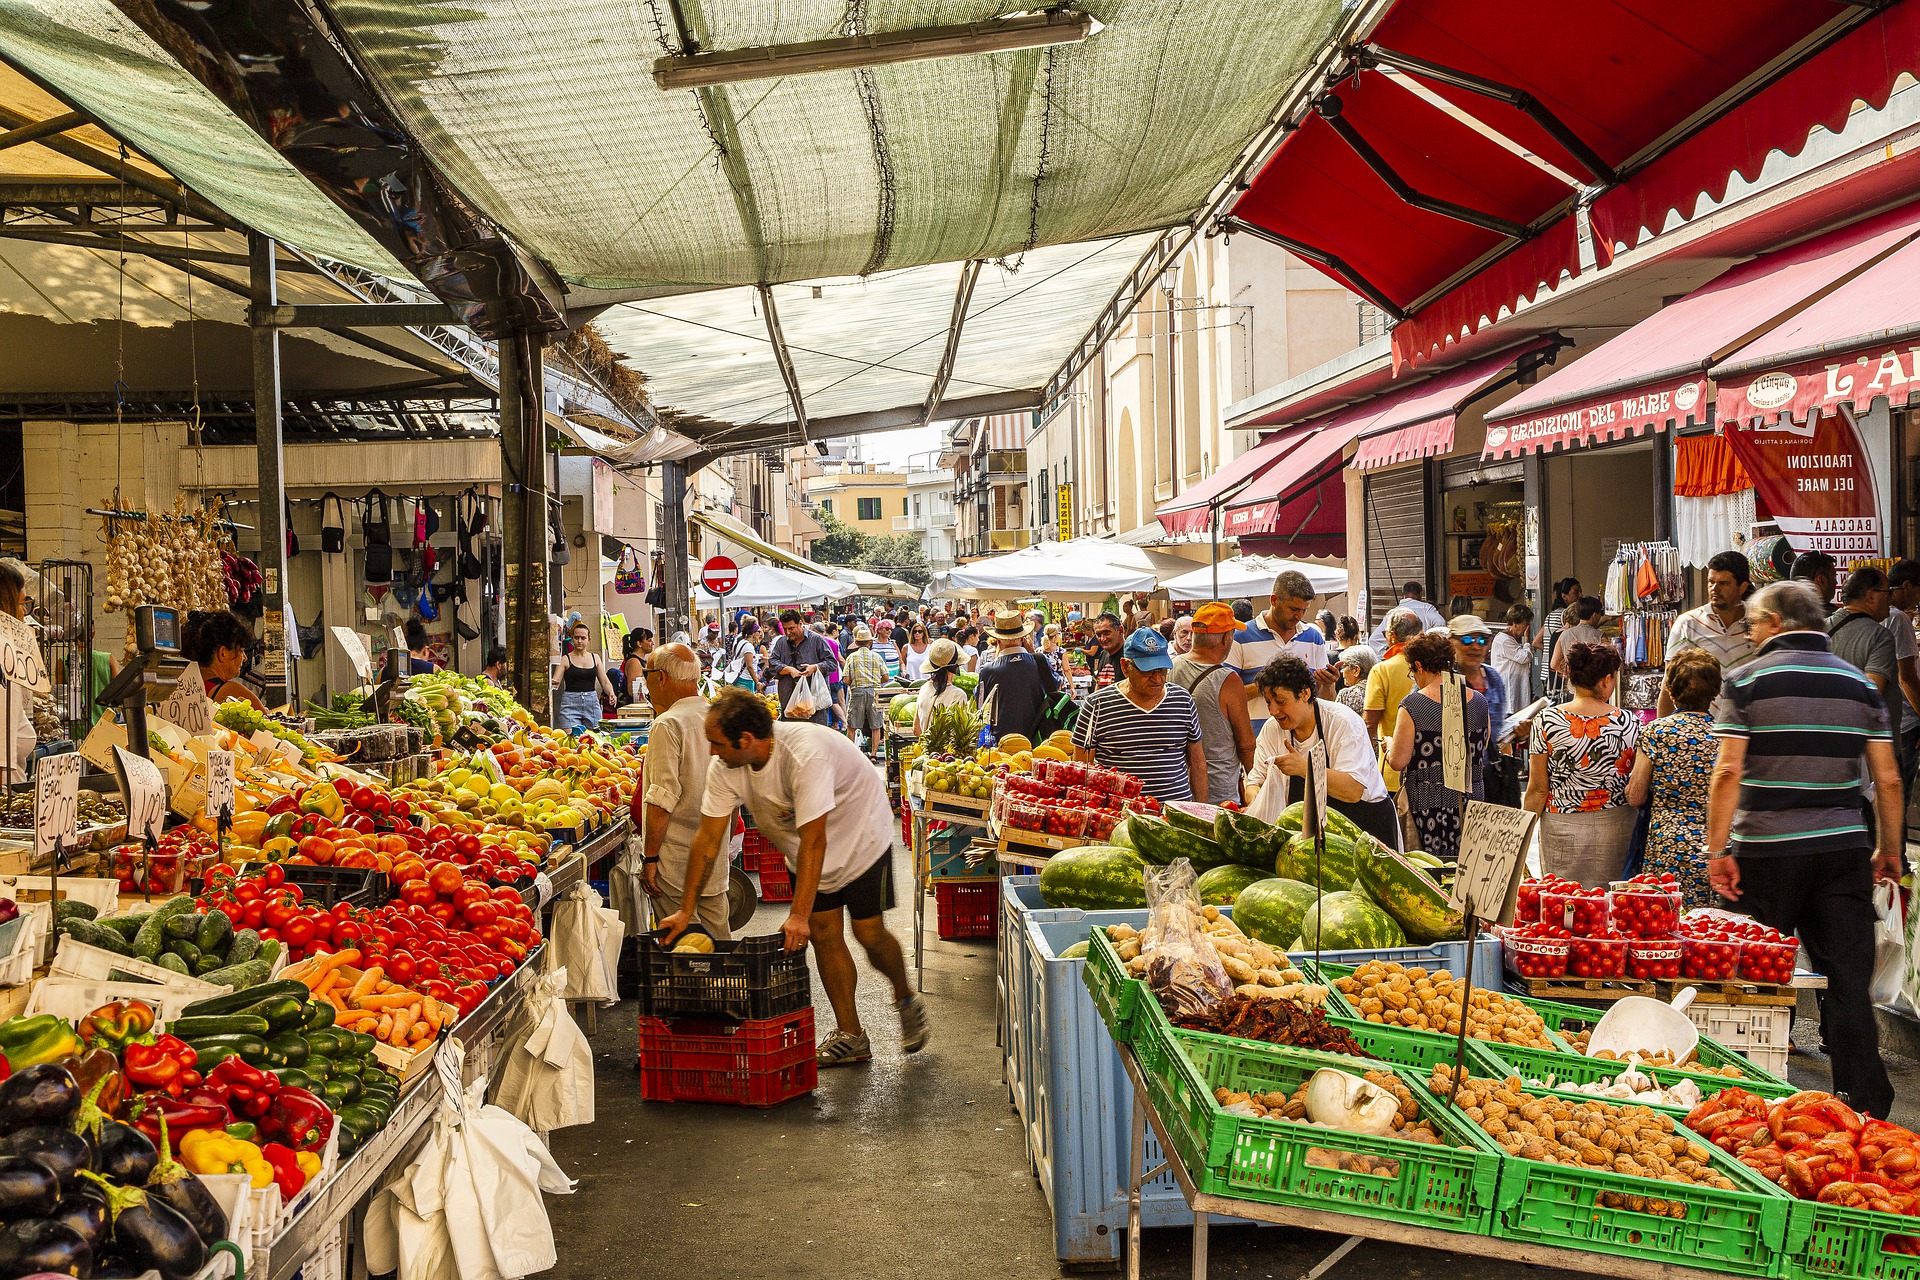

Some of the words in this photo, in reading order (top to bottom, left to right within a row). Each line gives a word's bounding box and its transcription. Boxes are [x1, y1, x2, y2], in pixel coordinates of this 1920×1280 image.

[1760, 375, 1790, 391] Cinque
[1824, 346, 1920, 400] L'A
[1511, 411, 1583, 442] TRADIZIONI
[1588, 402, 1616, 428] DEL
[1622, 391, 1671, 420] MARE
